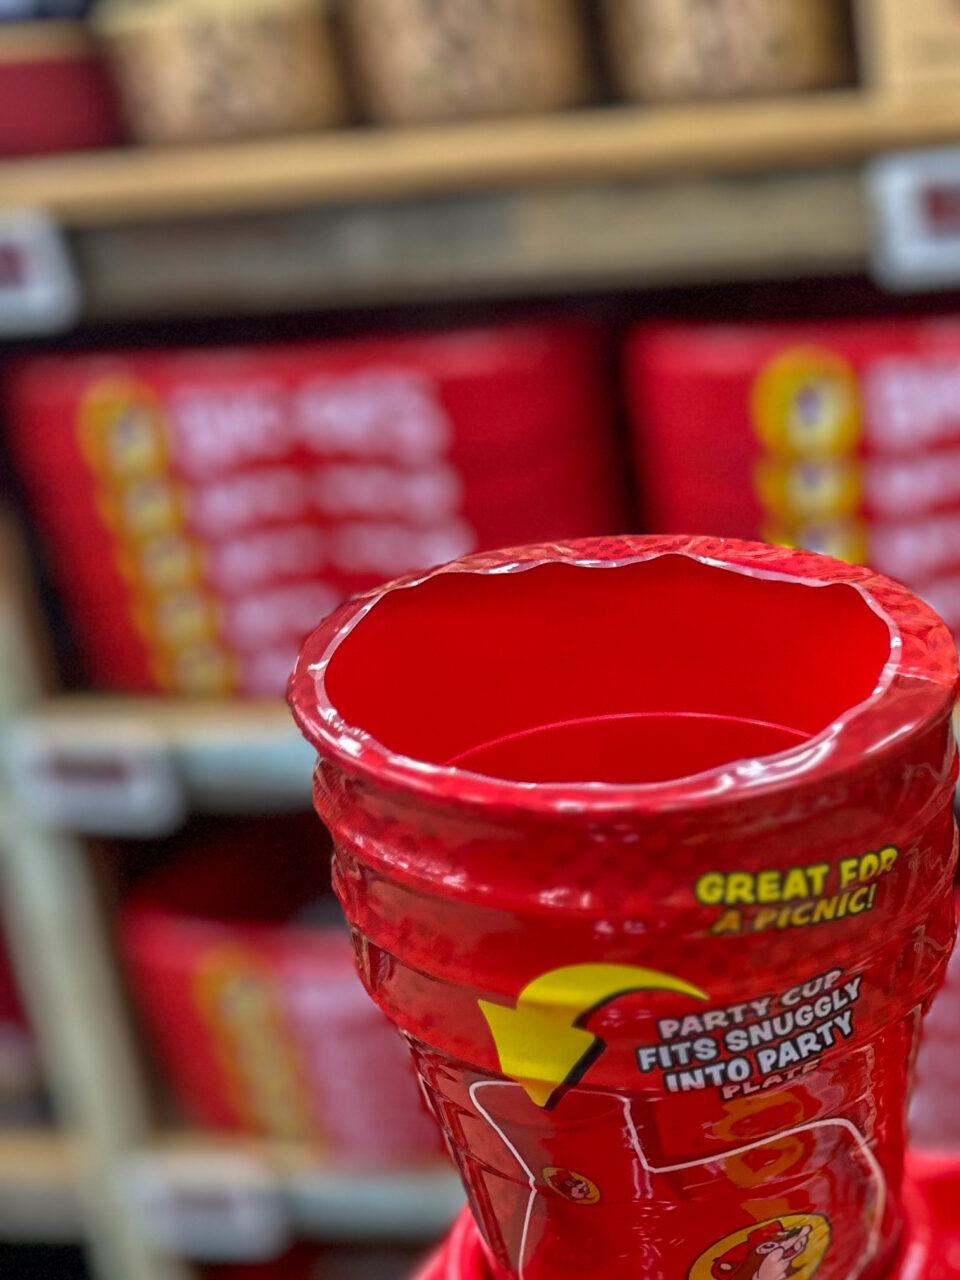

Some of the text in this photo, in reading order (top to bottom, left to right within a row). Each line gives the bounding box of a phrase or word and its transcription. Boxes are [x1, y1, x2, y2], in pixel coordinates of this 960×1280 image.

[696, 846, 899, 906] GREAT FOR
[710, 883, 878, 934] A PICNIC!
[637, 976, 862, 1072] FITS SNUGGLY
[657, 968, 843, 1041] PARTY CUP
[664, 1010, 853, 1093] INTO PARTY
[721, 1057, 822, 1100] PLATE
